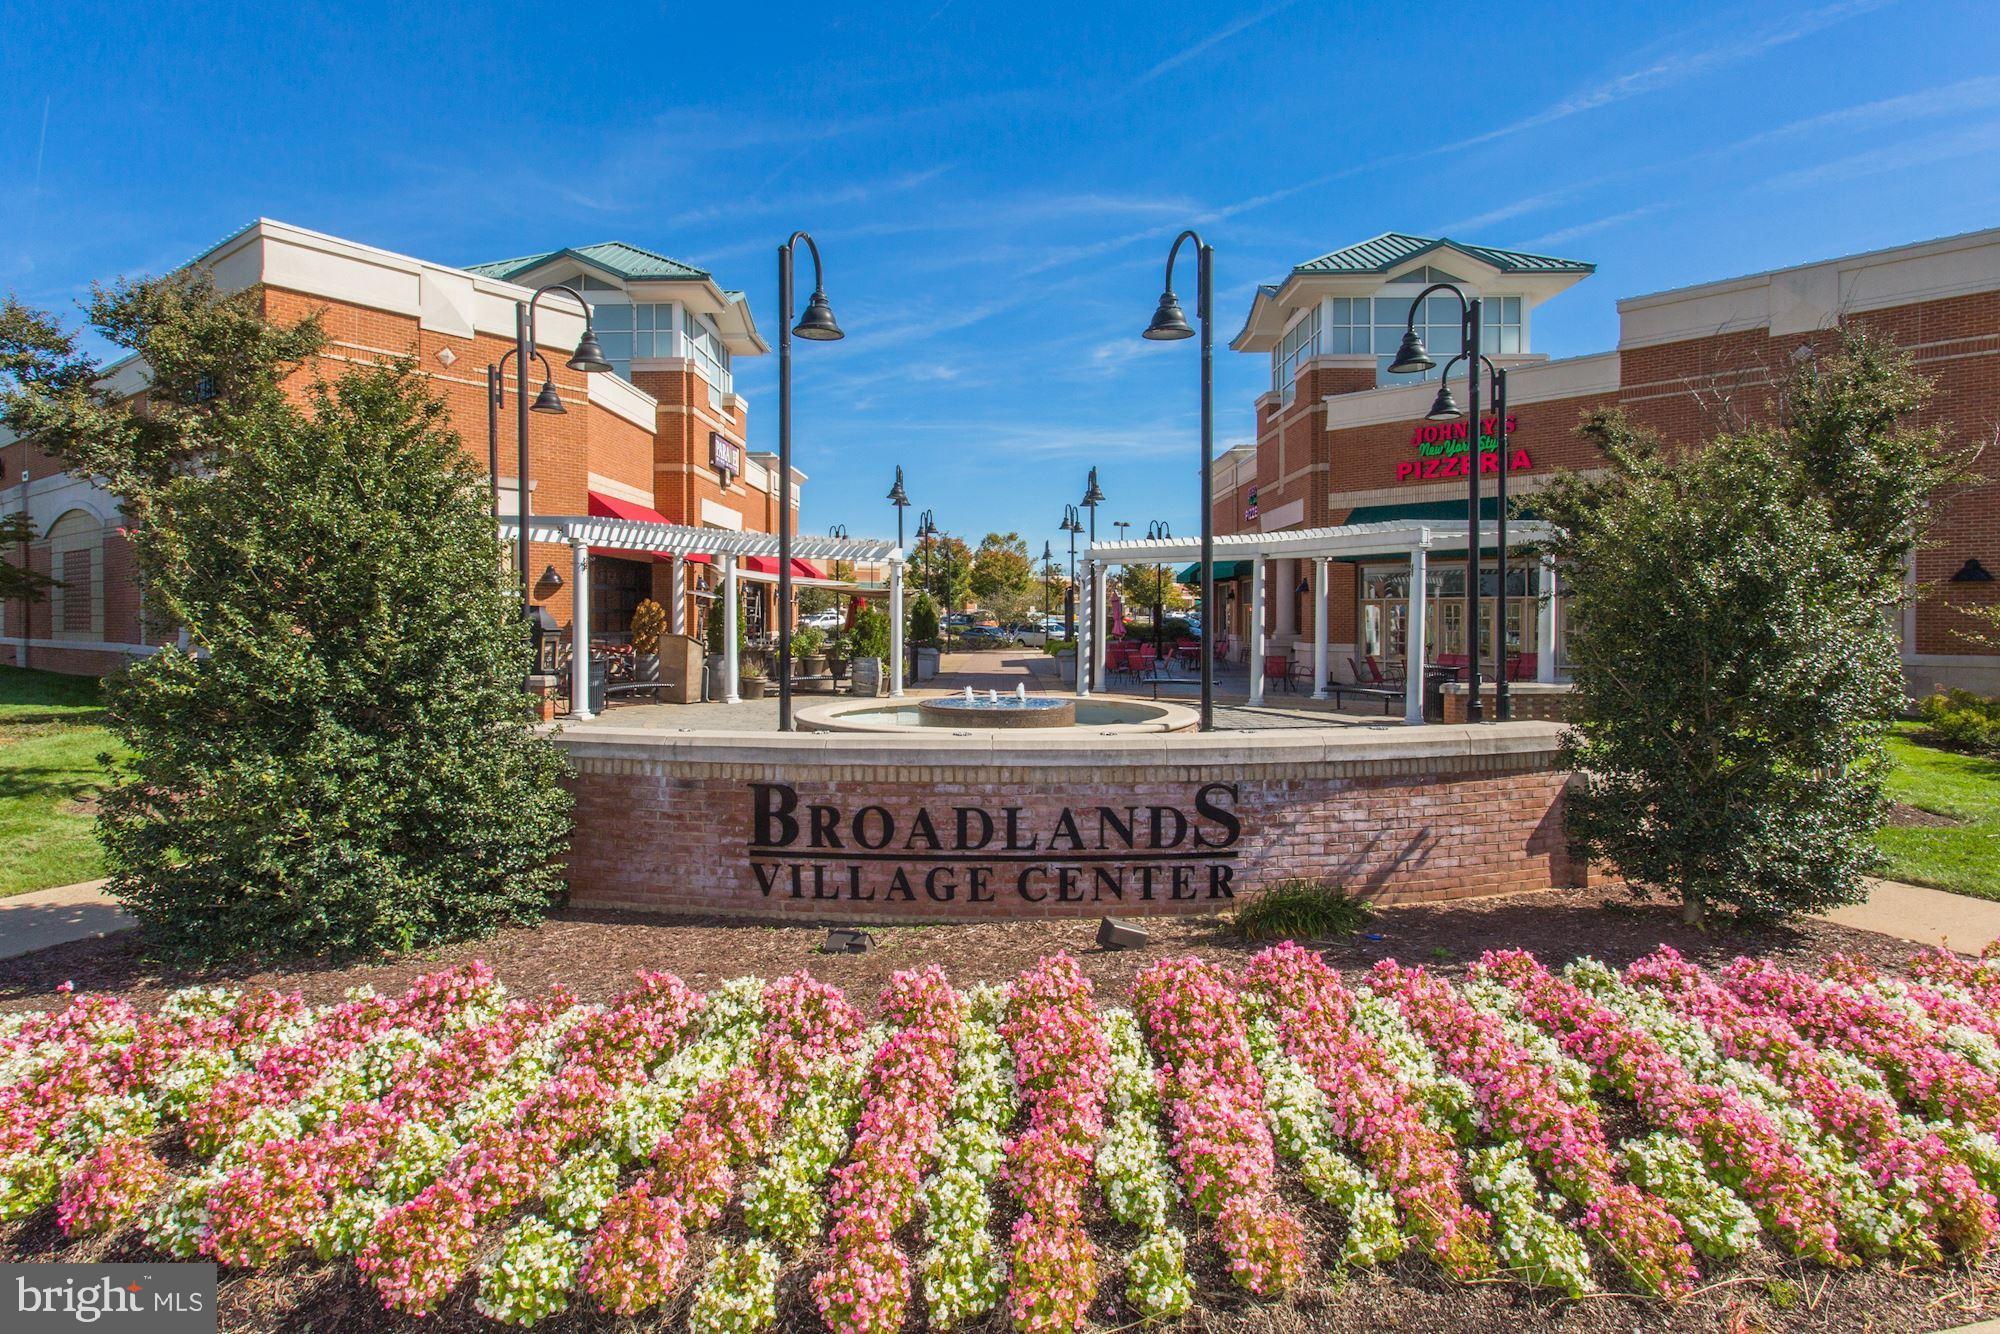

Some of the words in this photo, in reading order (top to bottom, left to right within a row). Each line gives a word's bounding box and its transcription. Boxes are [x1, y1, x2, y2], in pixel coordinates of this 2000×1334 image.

[1408, 414, 1517, 447] JOHNYS
[1419, 442, 1444, 457] New
[1444, 439, 1471, 457] Yor
[1477, 434, 1510, 453] Sty
[1395, 448, 1533, 481] PIZZERA
[747, 783, 1240, 850] BROADLANDS
[752, 862, 996, 902] VILLAGE
[1017, 864, 1235, 902] CENTER
